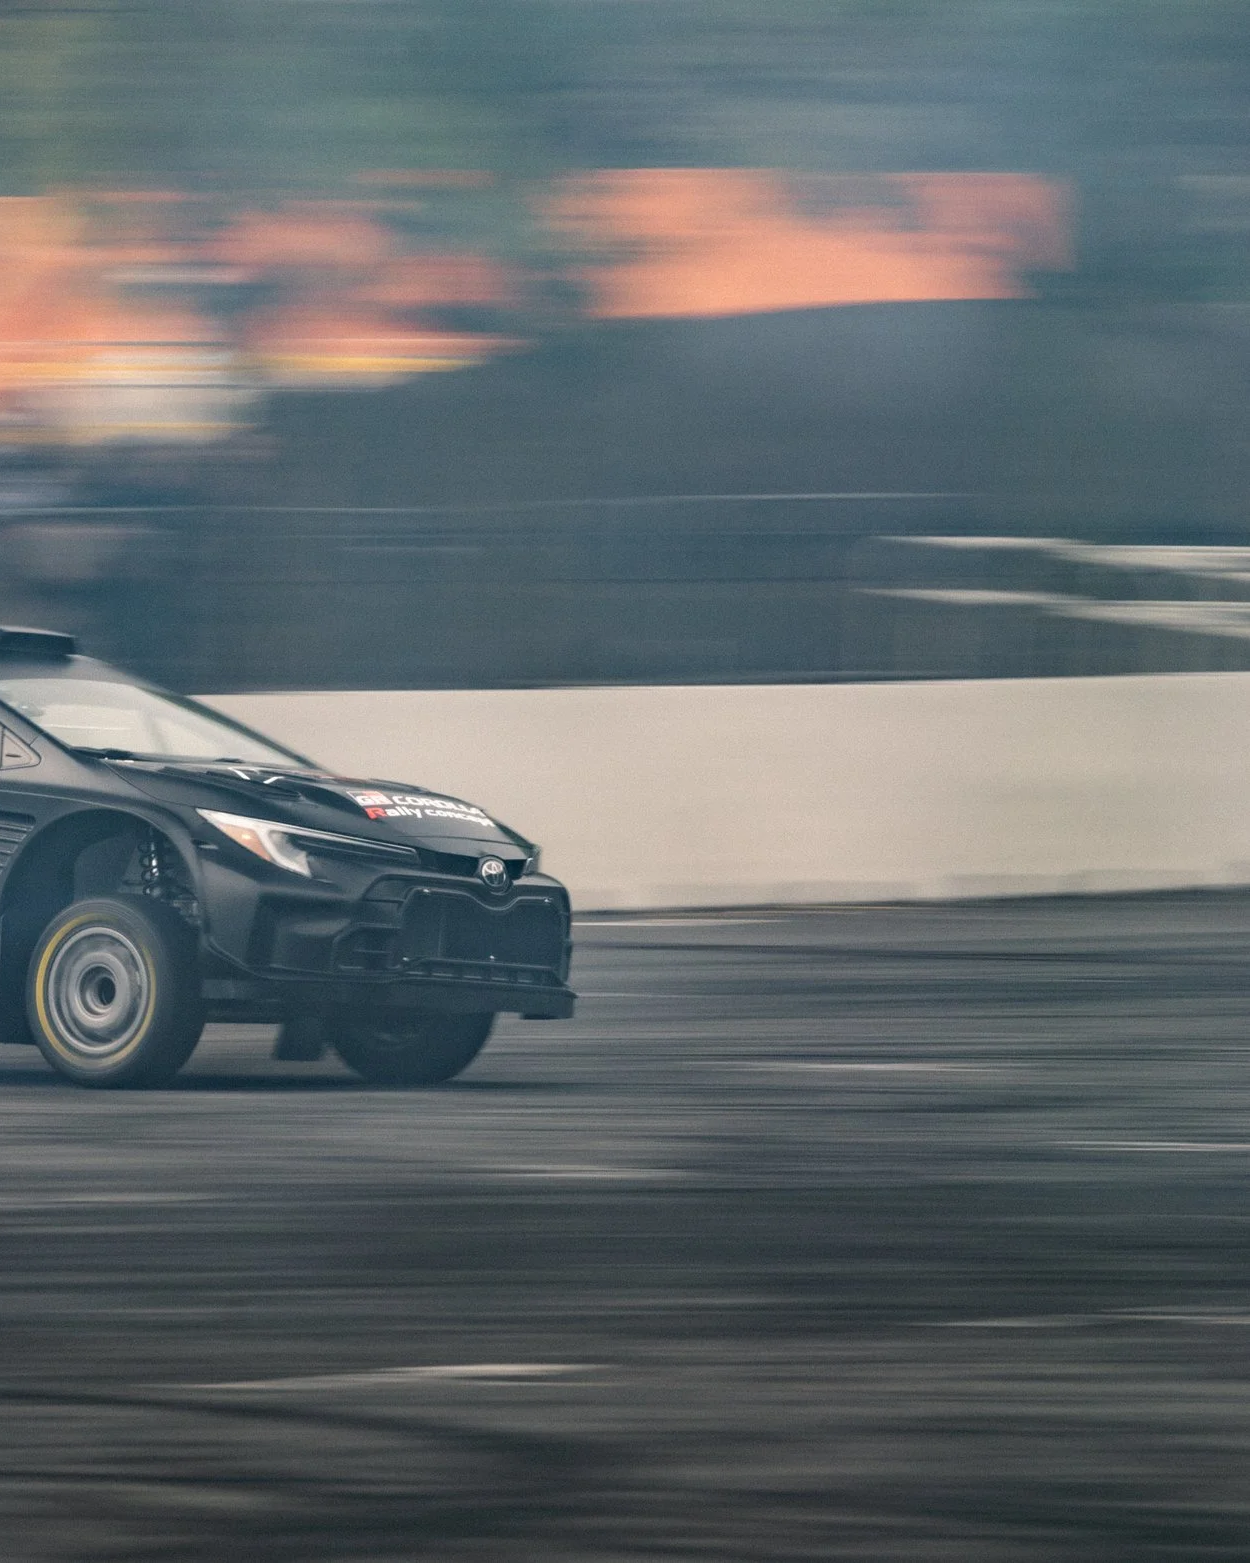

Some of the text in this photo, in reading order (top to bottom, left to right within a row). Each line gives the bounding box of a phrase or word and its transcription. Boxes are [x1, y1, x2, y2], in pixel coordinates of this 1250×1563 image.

[365, 806, 495, 828] Rally concept
[392, 795, 487, 817] COROLLA
